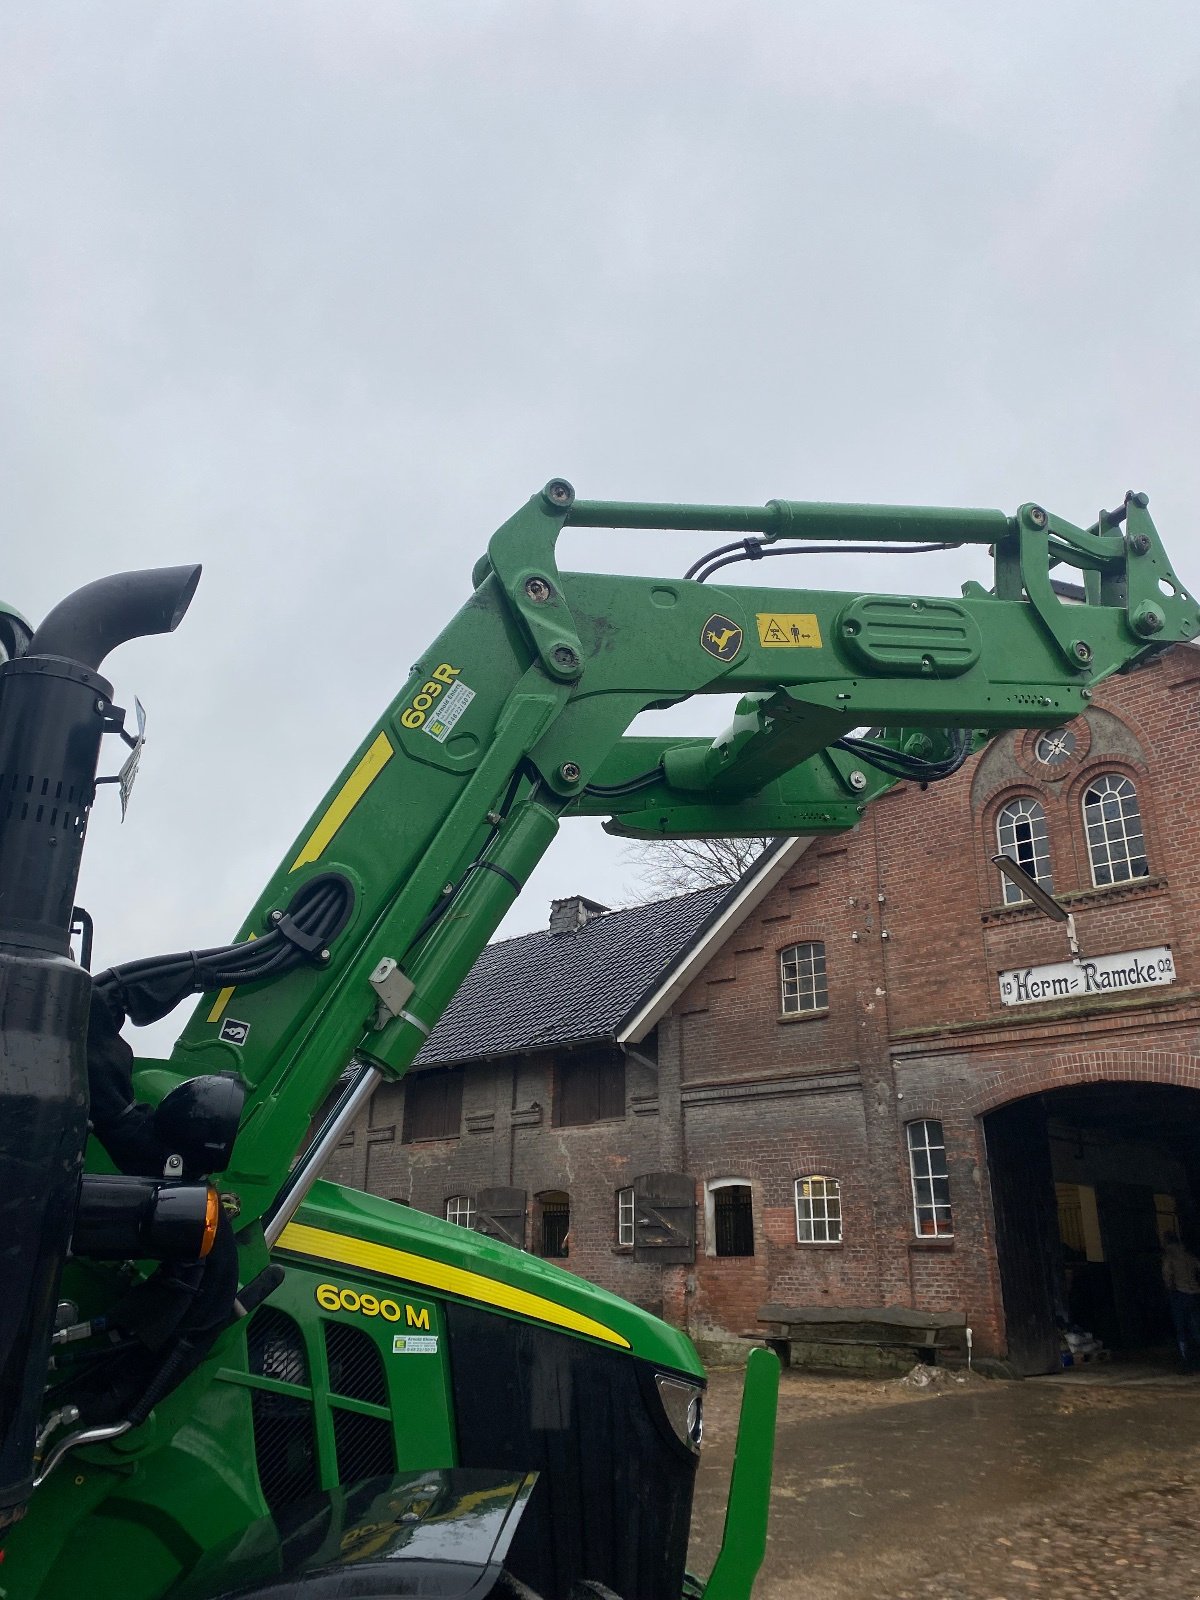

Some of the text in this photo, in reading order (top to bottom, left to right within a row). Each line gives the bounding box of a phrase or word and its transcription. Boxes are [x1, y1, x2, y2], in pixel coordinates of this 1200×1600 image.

[435, 699, 450, 718] Arnold
[1002, 982, 1012, 995] 19
[1157, 958, 1173, 973] 02
[315, 1284, 430, 1330] 6090 M
